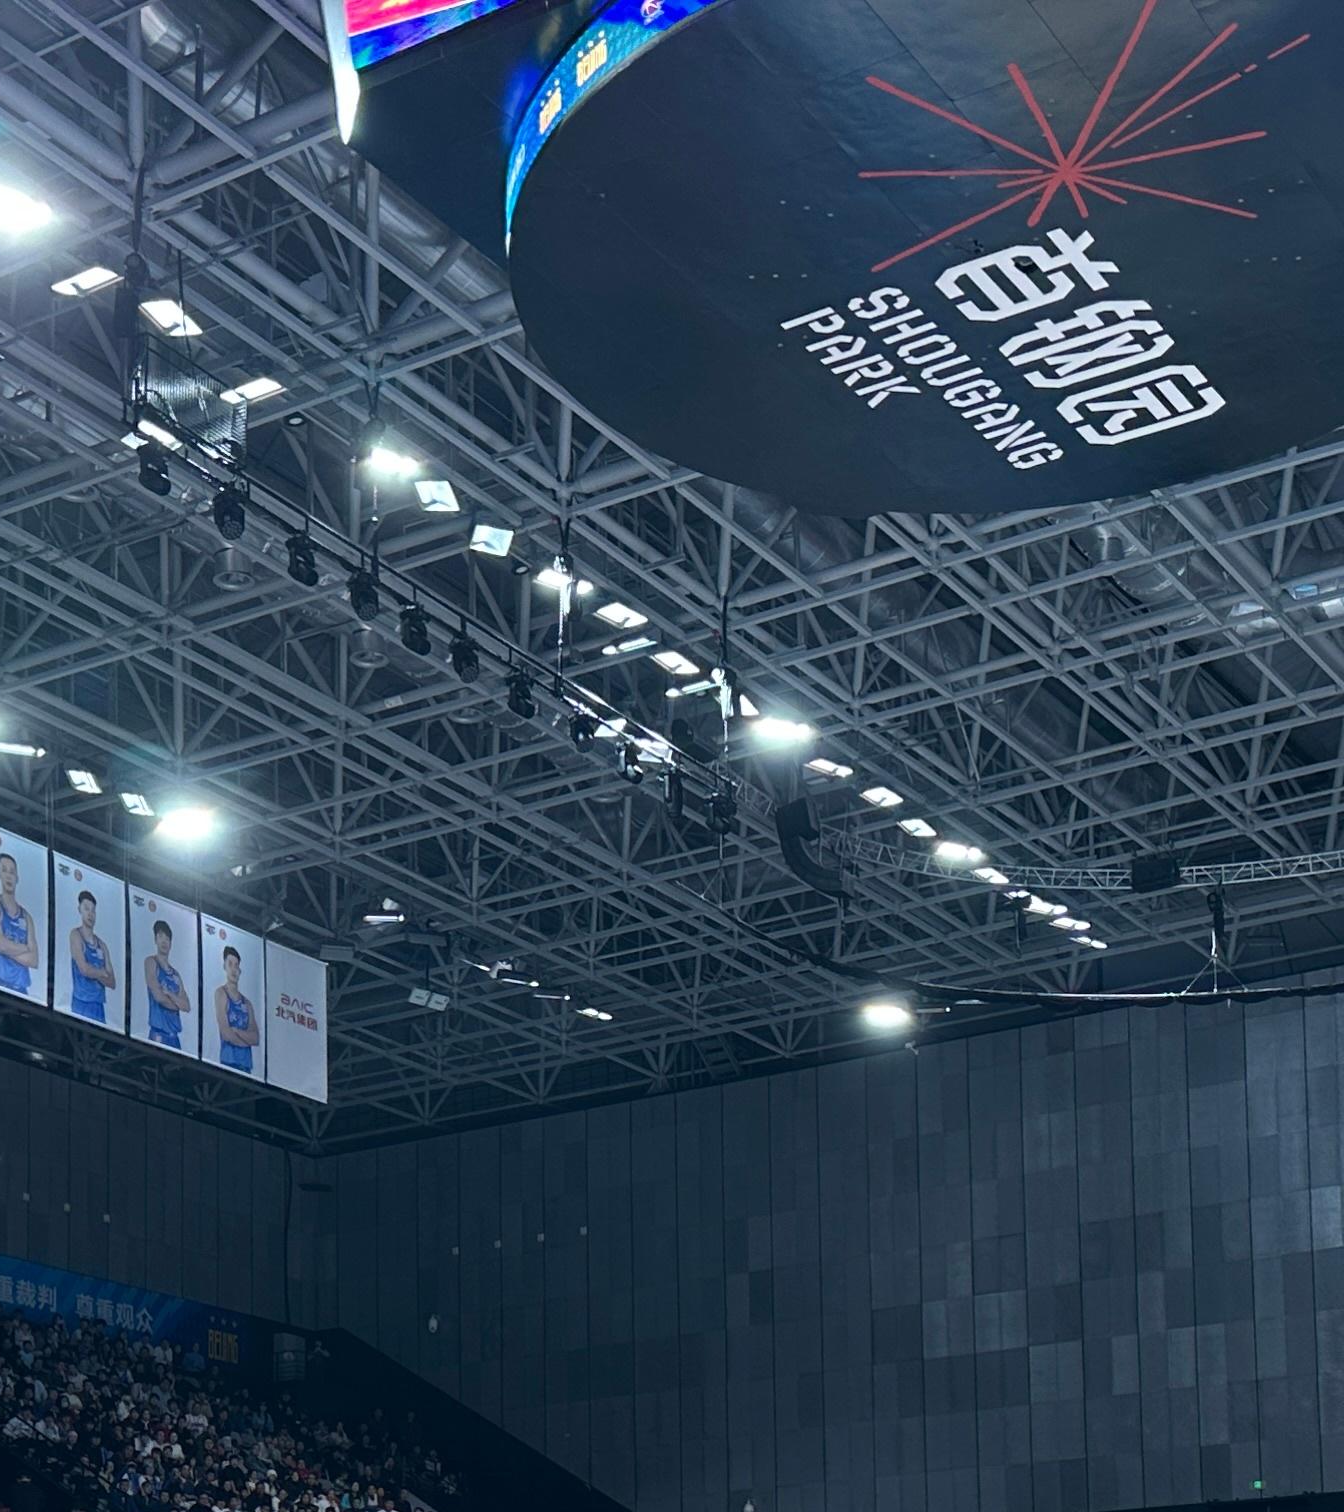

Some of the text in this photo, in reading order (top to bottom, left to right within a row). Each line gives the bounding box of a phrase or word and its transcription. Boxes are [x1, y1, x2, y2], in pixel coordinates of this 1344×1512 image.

[780, 306, 922, 409] PARK
[848, 286, 1063, 470] SHOUGANG
[275, 1005, 318, 1031] 北汽集团
[280, 993, 314, 1015] BAIC
